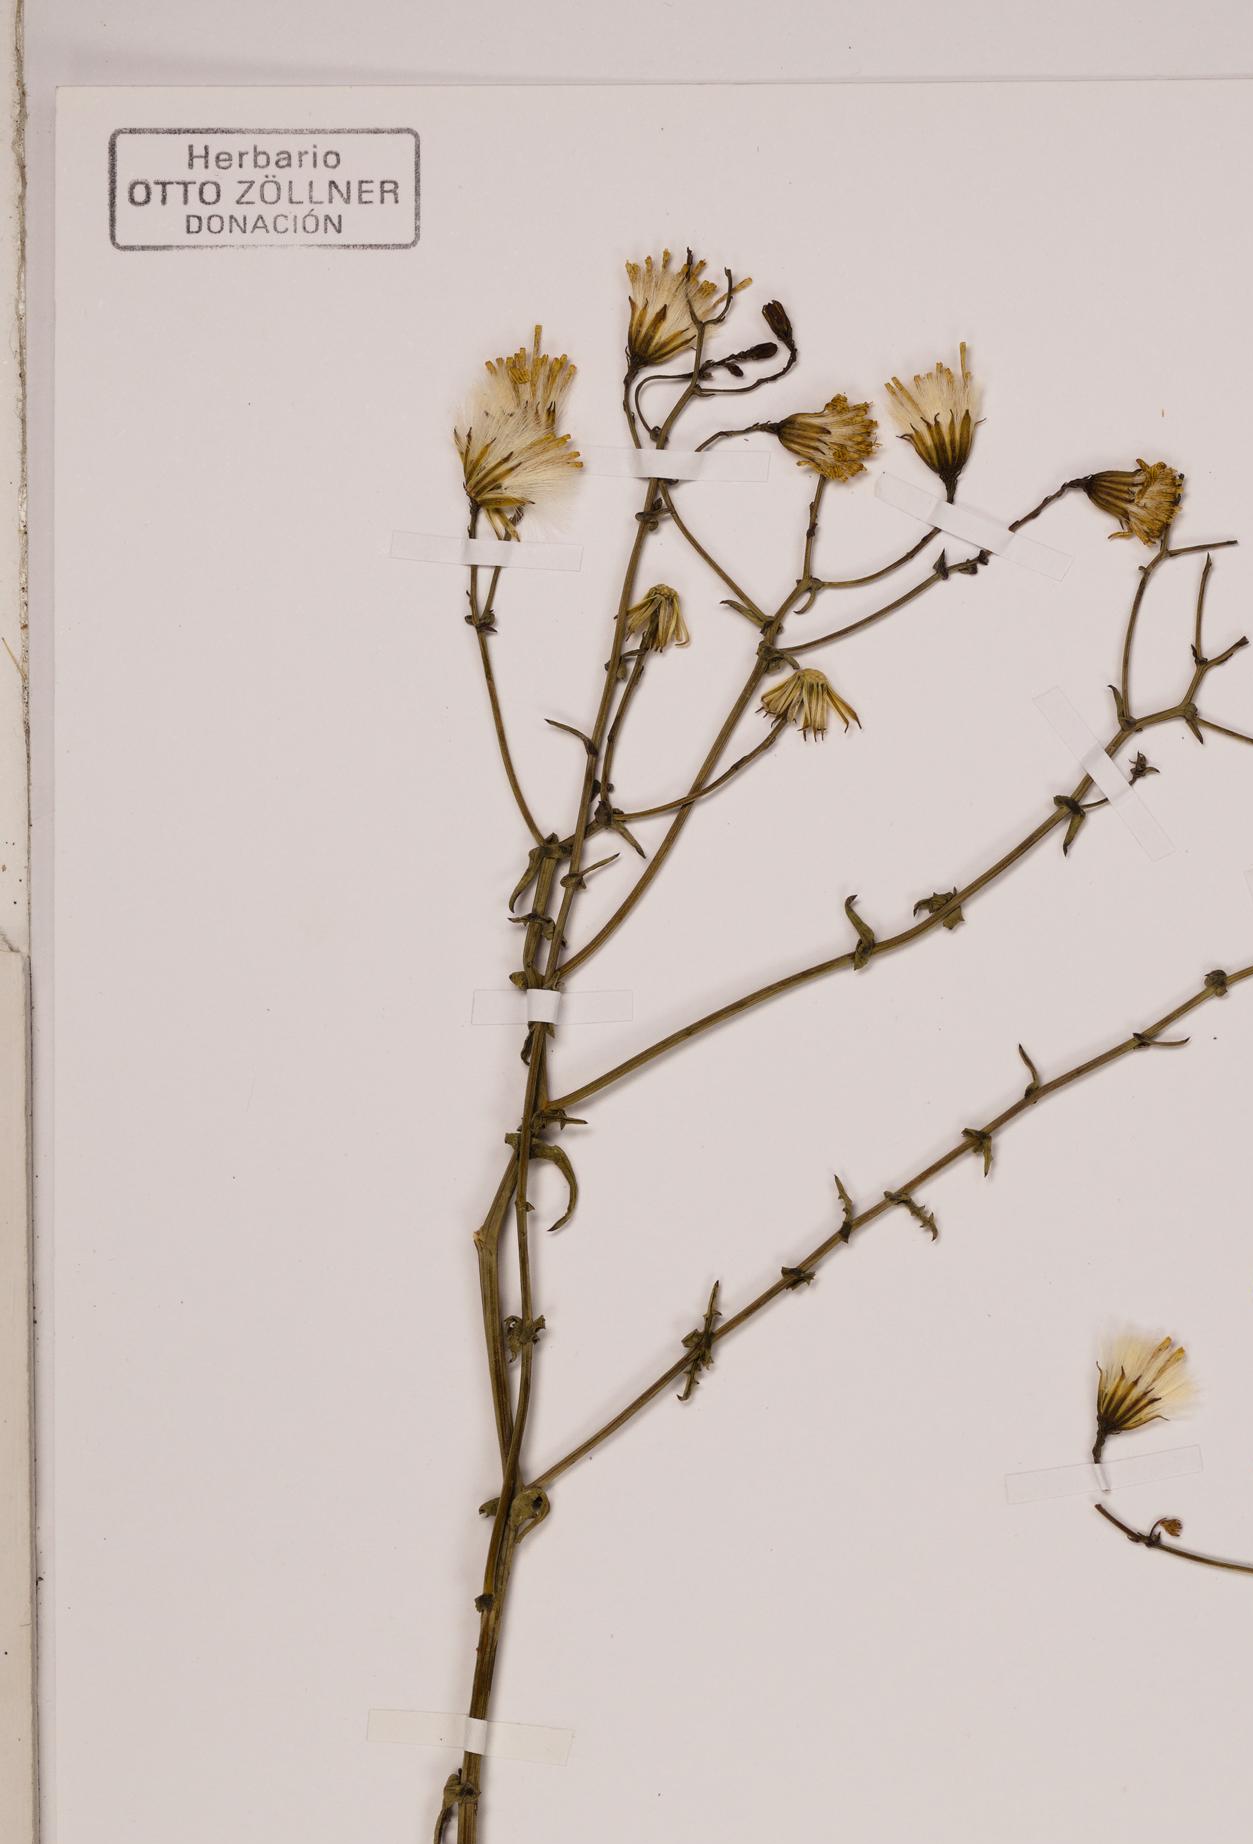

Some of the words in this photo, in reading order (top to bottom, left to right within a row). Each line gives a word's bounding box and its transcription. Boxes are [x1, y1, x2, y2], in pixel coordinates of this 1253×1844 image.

[187, 144, 341, 170] Herbario
[127, 179, 222, 207] OTTO
[235, 174, 400, 205] ZÖLLNER
[185, 209, 343, 234] DONACIÓN
